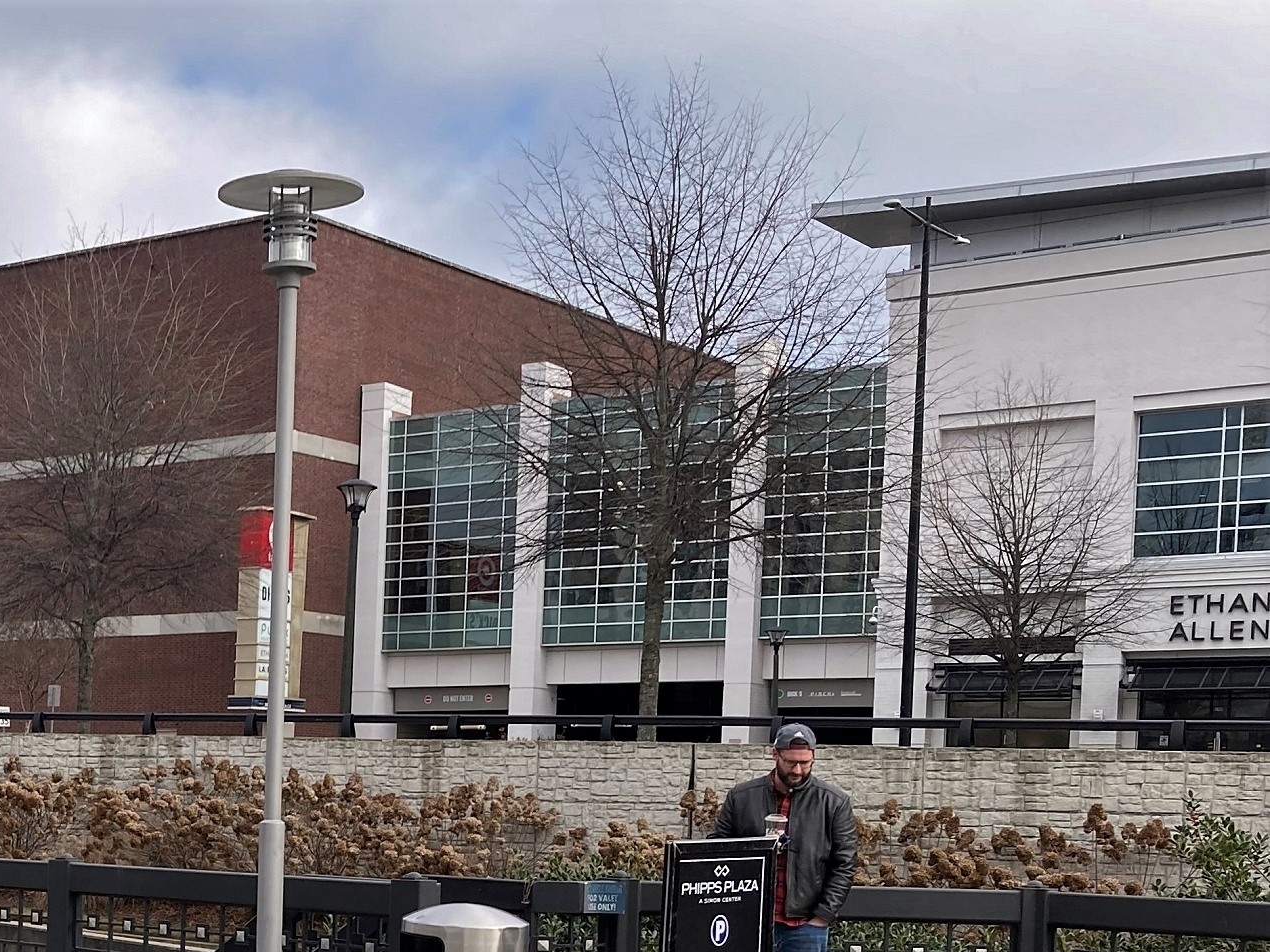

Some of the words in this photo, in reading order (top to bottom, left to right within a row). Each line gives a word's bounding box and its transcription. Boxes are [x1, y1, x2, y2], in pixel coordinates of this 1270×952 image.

[1170, 592, 1270, 615] ETHAN
[1169, 619, 1269, 642] ALLEN
[459, 694, 474, 702] ENTER
[681, 880, 722, 896] PHIPPS
[723, 879, 759, 893] PLAZA
[598, 894, 619, 902] VALET
